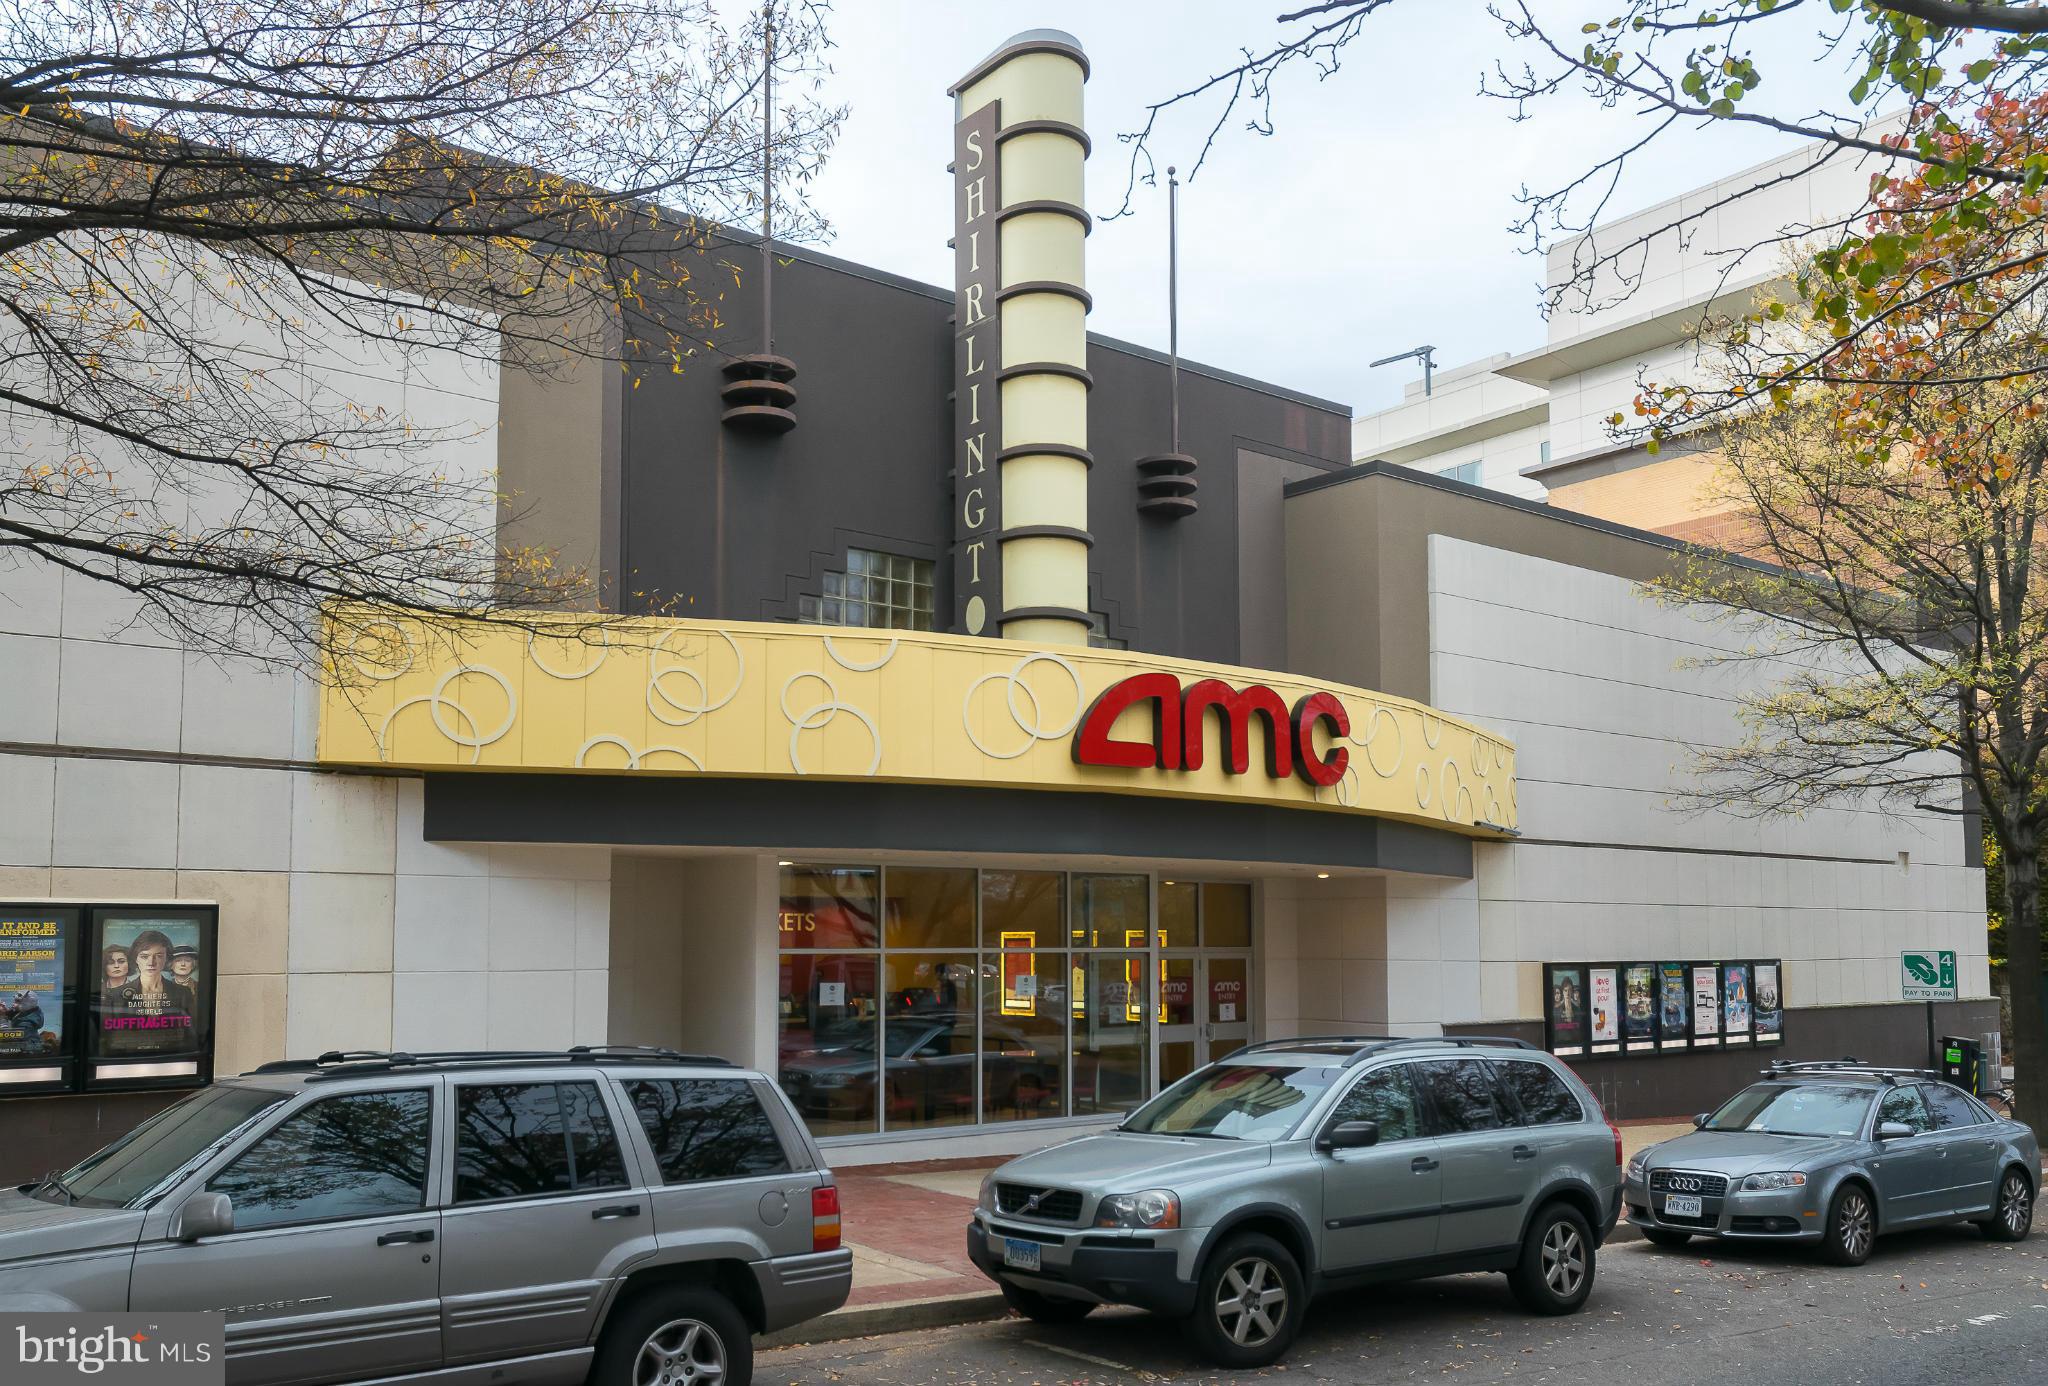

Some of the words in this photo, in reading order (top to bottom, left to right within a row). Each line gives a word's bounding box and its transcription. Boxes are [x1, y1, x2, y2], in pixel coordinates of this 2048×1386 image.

[1940, 954, 1952, 967] 4
[128, 1000, 171, 1008] DAUGHTERS
[135, 1008, 163, 1016] REBELS
[104, 1016, 192, 1031] SUFFRAGETTE
